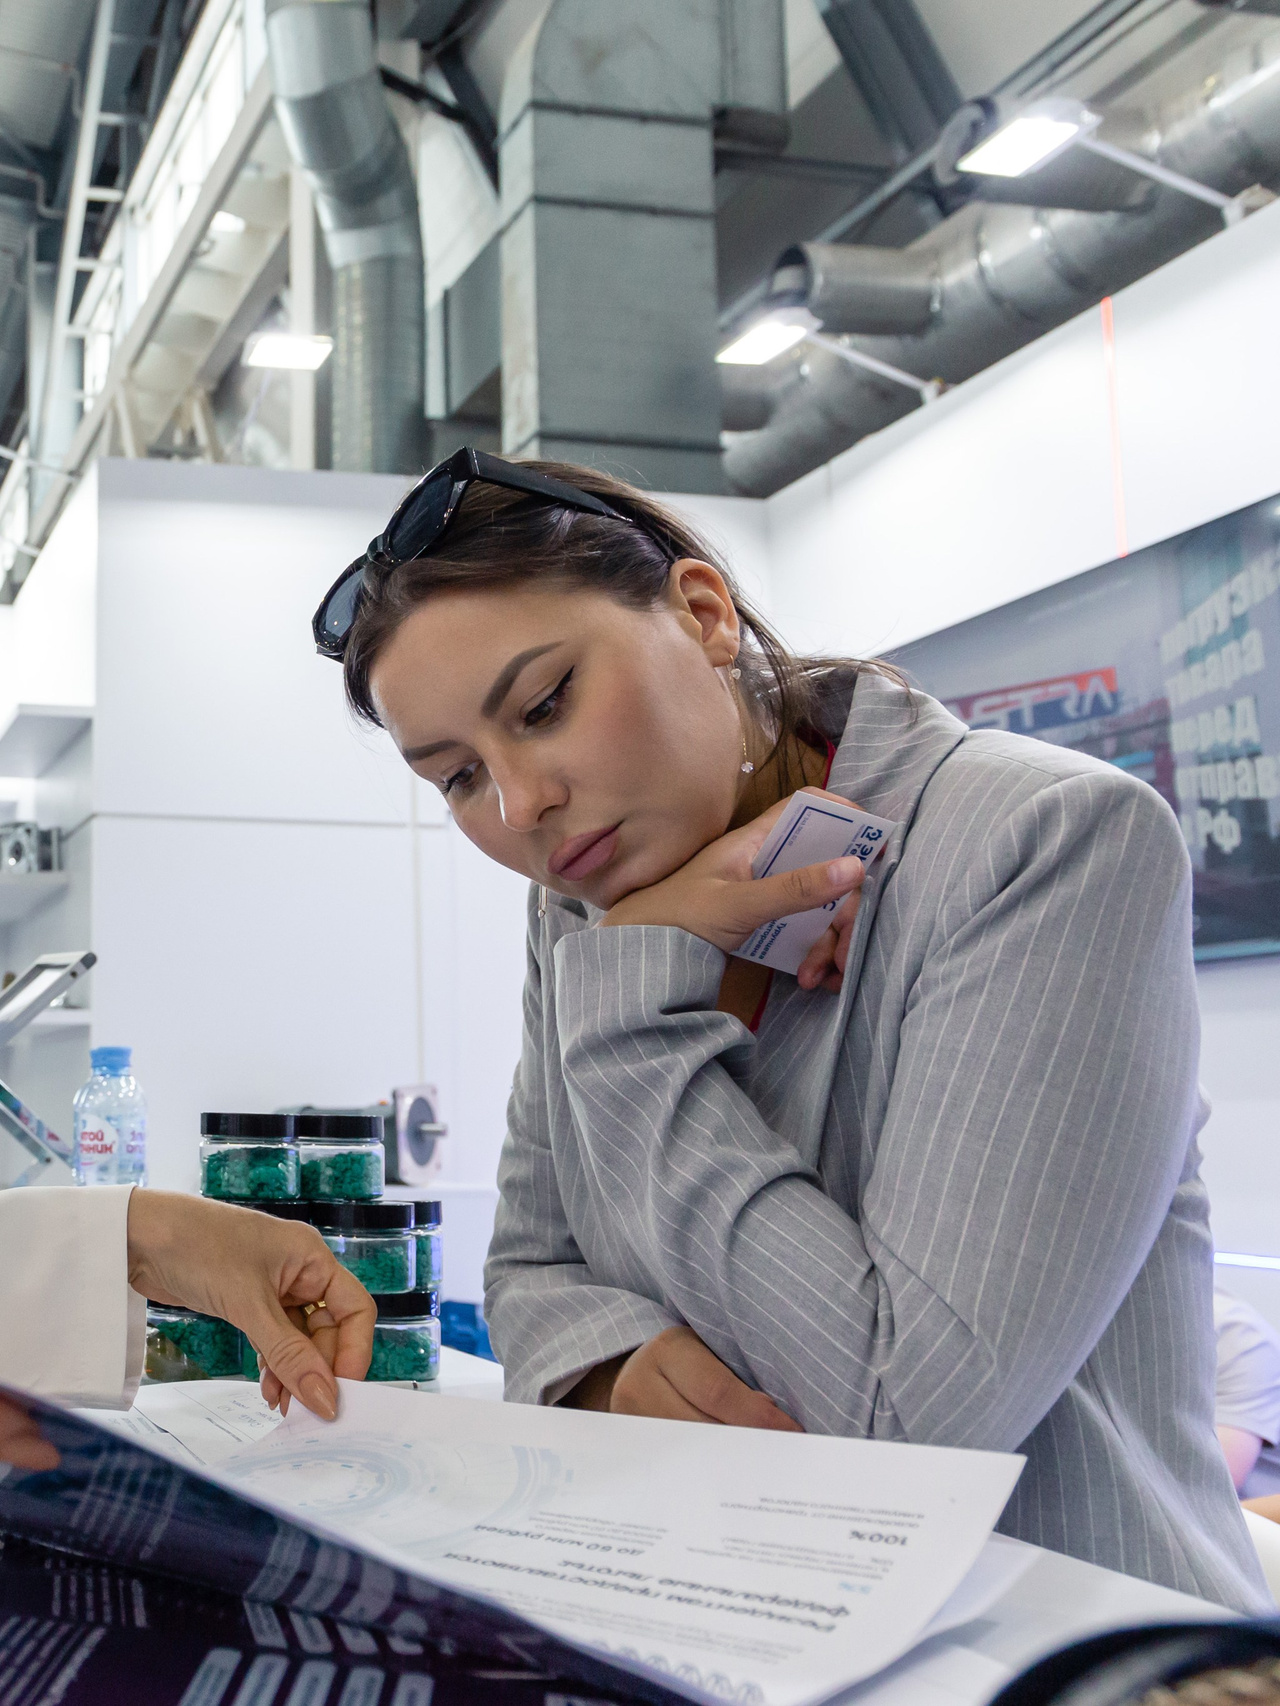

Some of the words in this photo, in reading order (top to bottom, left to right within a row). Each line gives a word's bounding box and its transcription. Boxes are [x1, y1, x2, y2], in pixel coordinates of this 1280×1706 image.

[1161, 545, 1280, 666] погрузк
[1176, 755, 1280, 805] отправ
[1196, 806, 1242, 854] РФ
[749, 918, 777, 957] икторовна
[473, 1523, 544, 1543] рублей
[848, 1529, 908, 1547] 100%
[443, 1551, 661, 1599] предоставляются
[657, 1576, 851, 1618] федеральные
[665, 1592, 837, 1633] Резидентам
